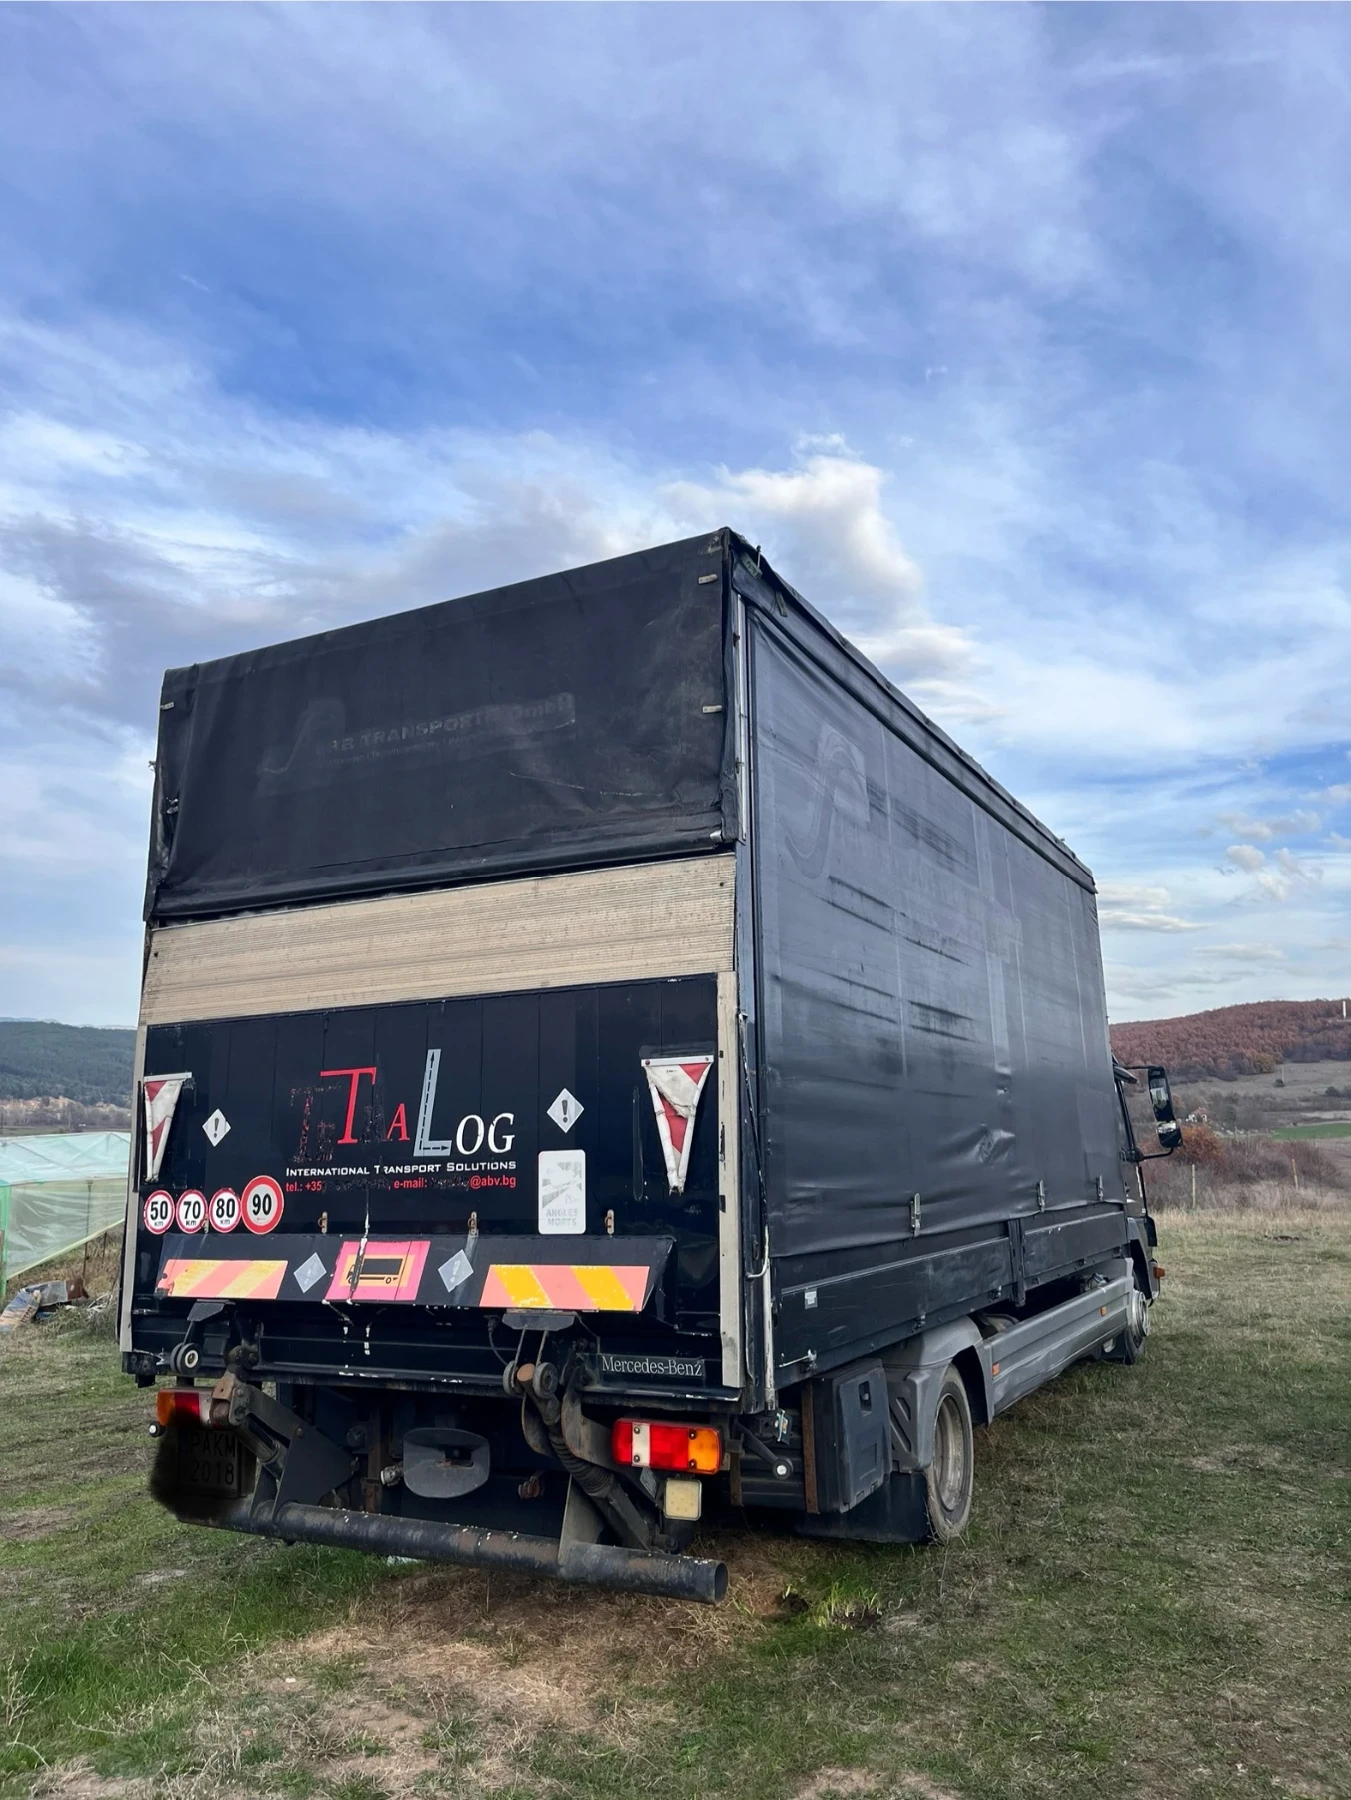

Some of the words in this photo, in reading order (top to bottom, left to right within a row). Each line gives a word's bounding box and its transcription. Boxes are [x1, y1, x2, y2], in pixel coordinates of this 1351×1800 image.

[446, 1161, 517, 1172] SOLUTIONS
[393, 1177, 428, 1189] e-mail:
[150, 1200, 169, 1220] 50
[183, 1200, 201, 1220] 70
[215, 1198, 236, 1219] 80
[252, 1193, 272, 1216] 90
[602, 1356, 703, 1377] Mercedes-Benz
